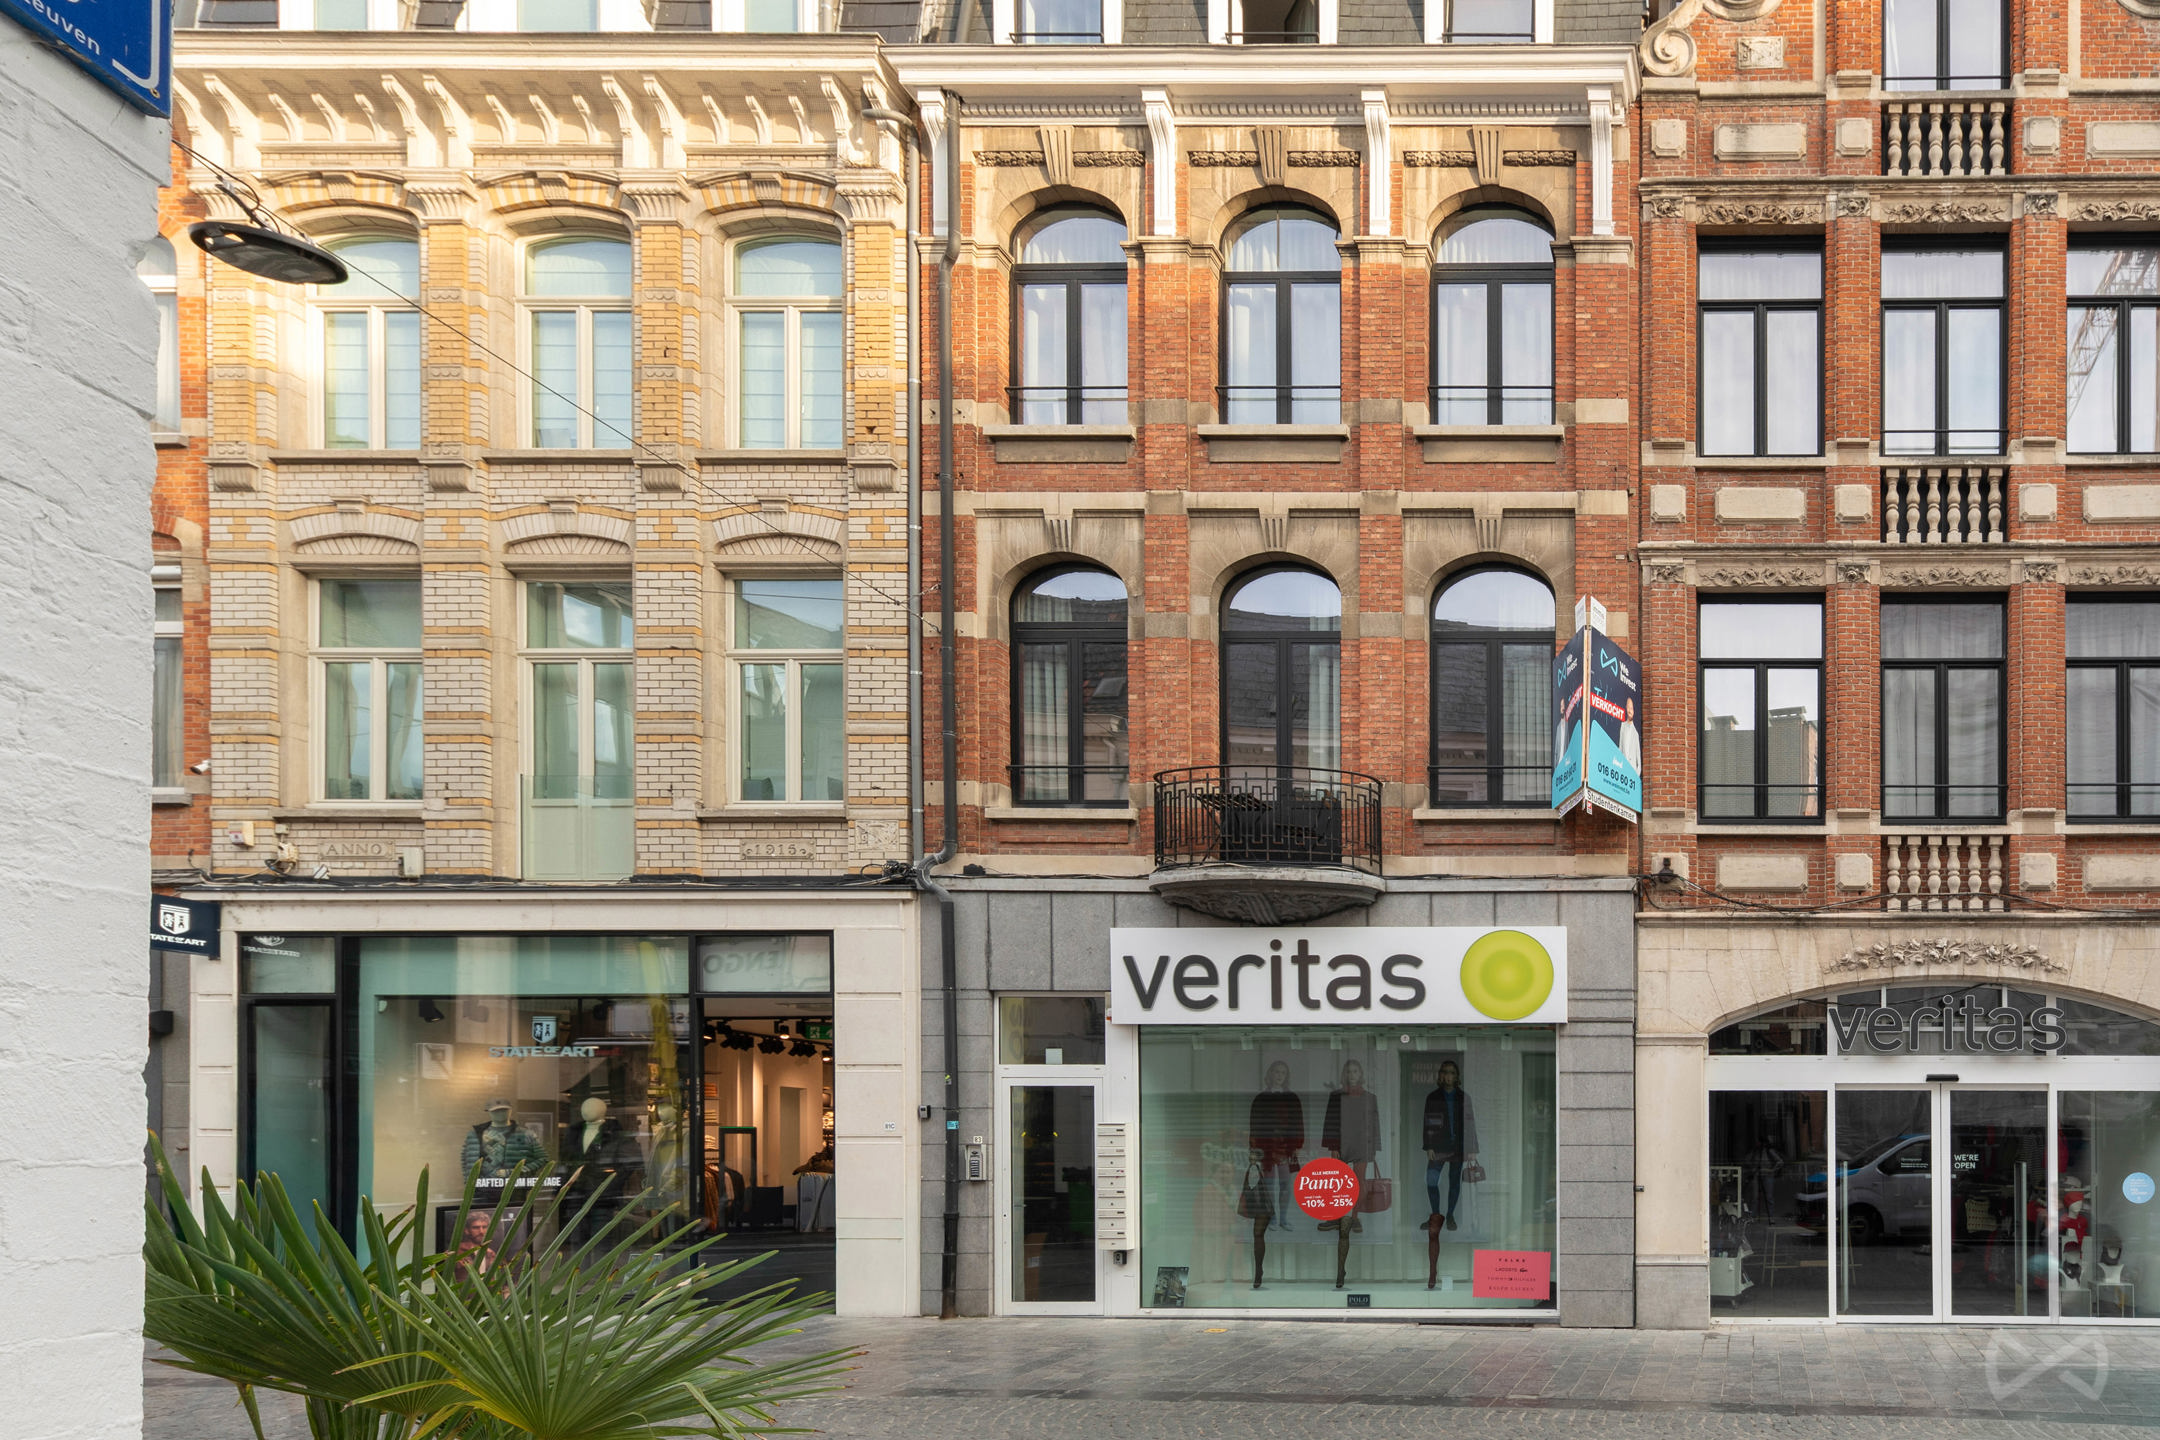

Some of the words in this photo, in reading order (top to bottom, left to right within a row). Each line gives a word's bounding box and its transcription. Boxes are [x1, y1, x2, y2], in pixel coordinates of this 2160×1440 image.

[24, 0, 100, 55] euven
[1591, 694, 1625, 720] VERKOCHT
[1598, 762, 1609, 776] 016
[1611, 769, 1619, 781] 60
[1621, 774, 1629, 786] 60
[1630, 779, 1636, 790] 31
[327, 843, 382, 855] ANNO
[755, 844, 797, 855] 1915
[149, 933, 175, 943] TATE
[184, 938, 207, 947] ART
[1123, 939, 1426, 1010] veritas
[1828, 995, 2067, 1051] veritas
[488, 1046, 541, 1057] STATE
[560, 1046, 599, 1057] ART
[475, 1178, 504, 1187] RAFTED
[526, 1177, 562, 1187] HEAGE
[1299, 1174, 1354, 1193] Panty's
[1301, 1199, 1325, 1208] -10%
[1329, 1198, 1353, 1207] -25%
